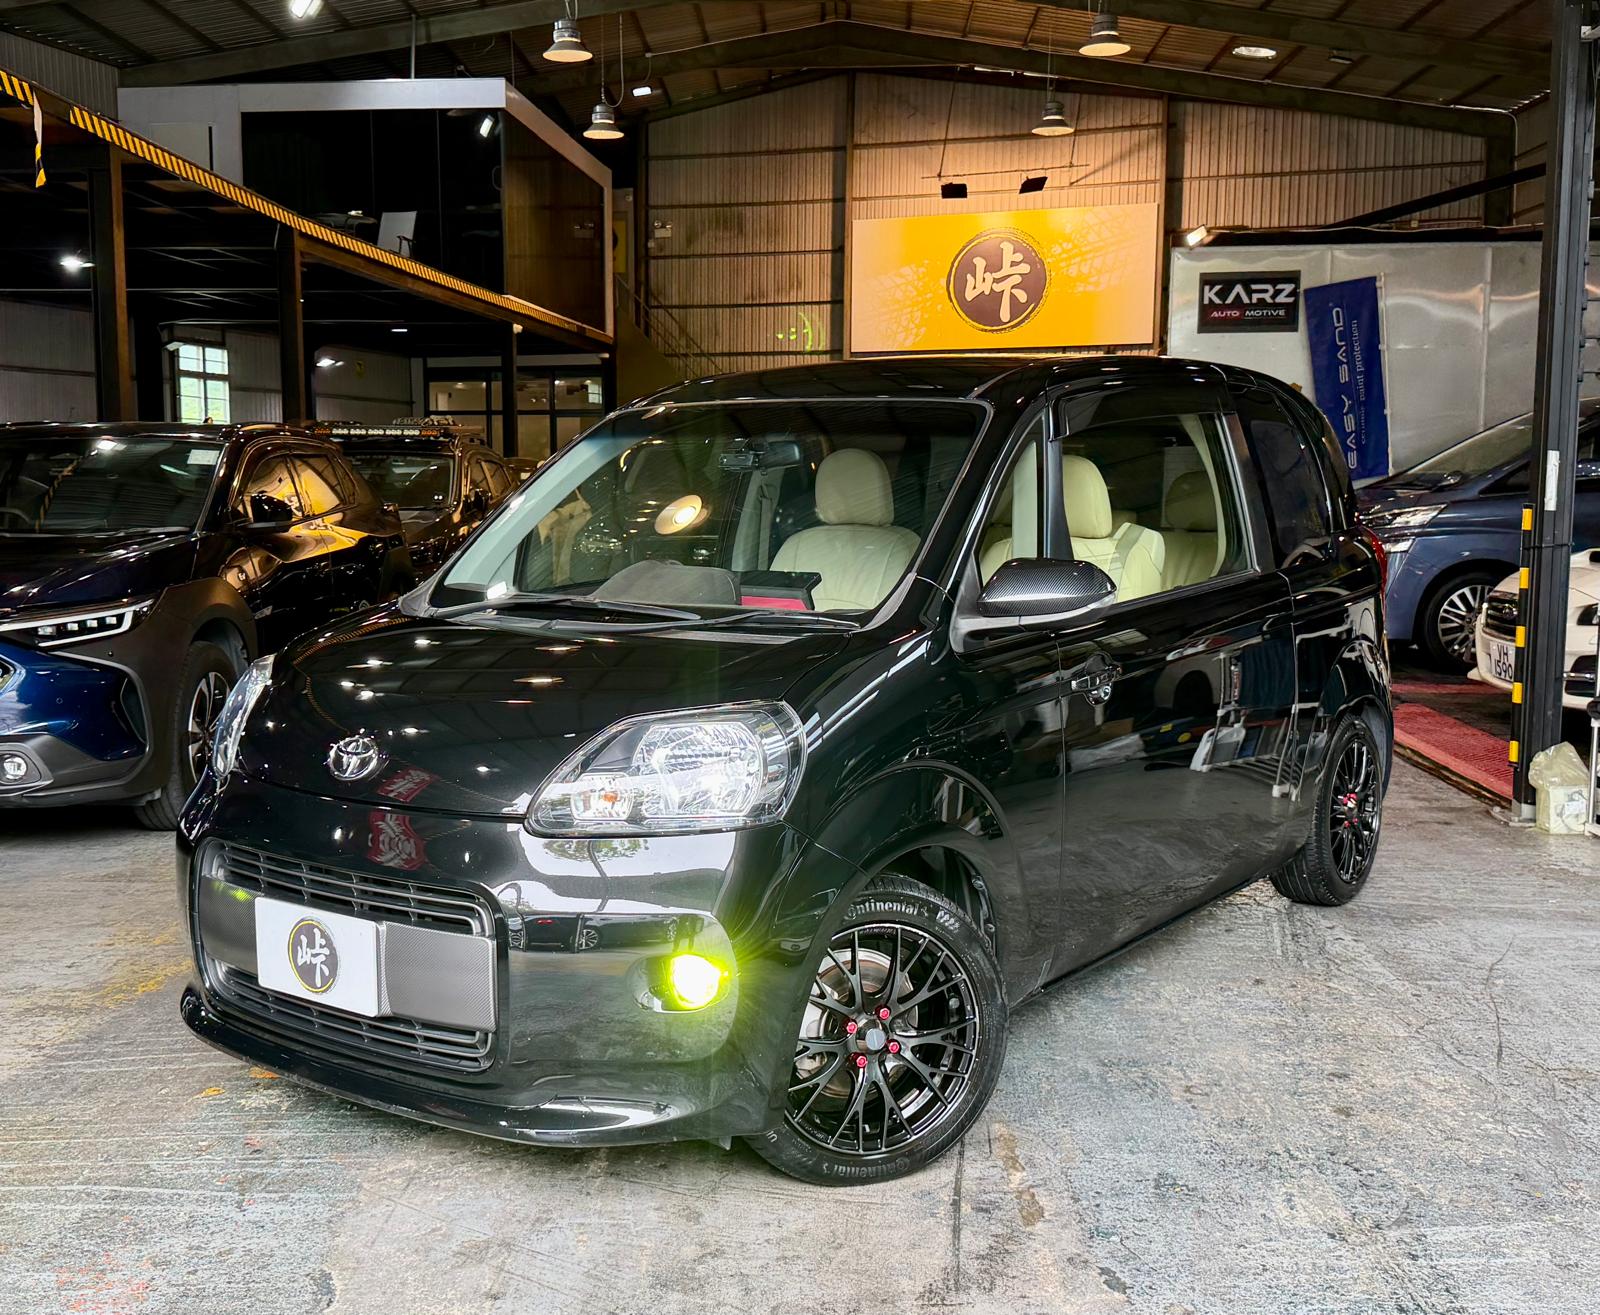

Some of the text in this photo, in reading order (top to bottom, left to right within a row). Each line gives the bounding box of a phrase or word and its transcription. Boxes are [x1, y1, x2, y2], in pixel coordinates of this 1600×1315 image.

[964, 241, 1031, 323] 峠
[1203, 283, 1296, 305] KARZ
[1210, 309, 1287, 318] AUTO MOTIVE
[1351, 320, 1365, 372] protection
[1332, 307, 1358, 469] EASY SAND
[1356, 374, 1366, 401] paint
[843, 899, 920, 920] Continental
[297, 927, 330, 988] 峠
